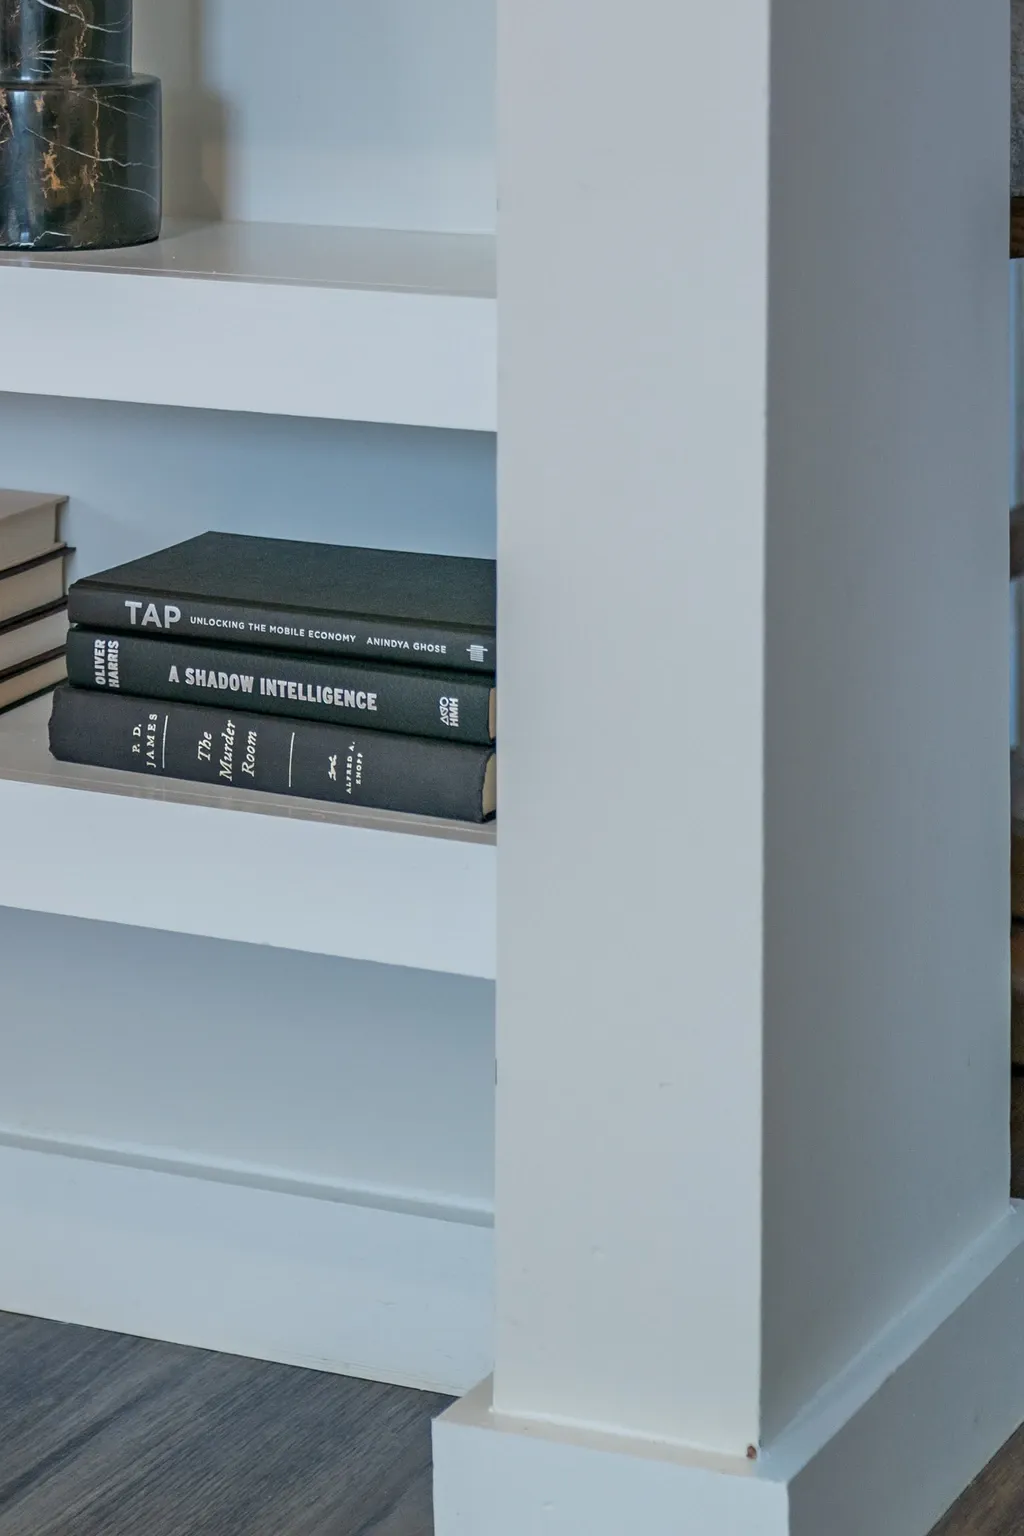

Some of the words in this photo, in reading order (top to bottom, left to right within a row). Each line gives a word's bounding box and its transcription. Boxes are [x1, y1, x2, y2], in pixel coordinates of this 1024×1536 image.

[124, 600, 182, 629] TAP
[190, 616, 245, 630] UNLOCKING
[248, 622, 266, 633] THE
[269, 625, 305, 637] MOBILE
[308, 630, 356, 643] ECONOMY
[366, 637, 410, 649] ANINDYA
[413, 642, 447, 654] GHOSE
[94, 639, 106, 685] OLIVER
[107, 640, 120, 688] HARRIS
[168, 665, 180, 683] A
[185, 667, 254, 694] SHADOW
[259, 677, 378, 711] INTELLIGENCE
[133, 724, 142, 737] D.
[448, 697, 459, 727] HMH
[131, 743, 141, 753] P.
[146, 713, 158, 768] JAMES
[197, 731, 213, 761] The
[219, 719, 236, 782] Murder
[241, 730, 258, 777] Room
[345, 755, 353, 795] ALFRED
